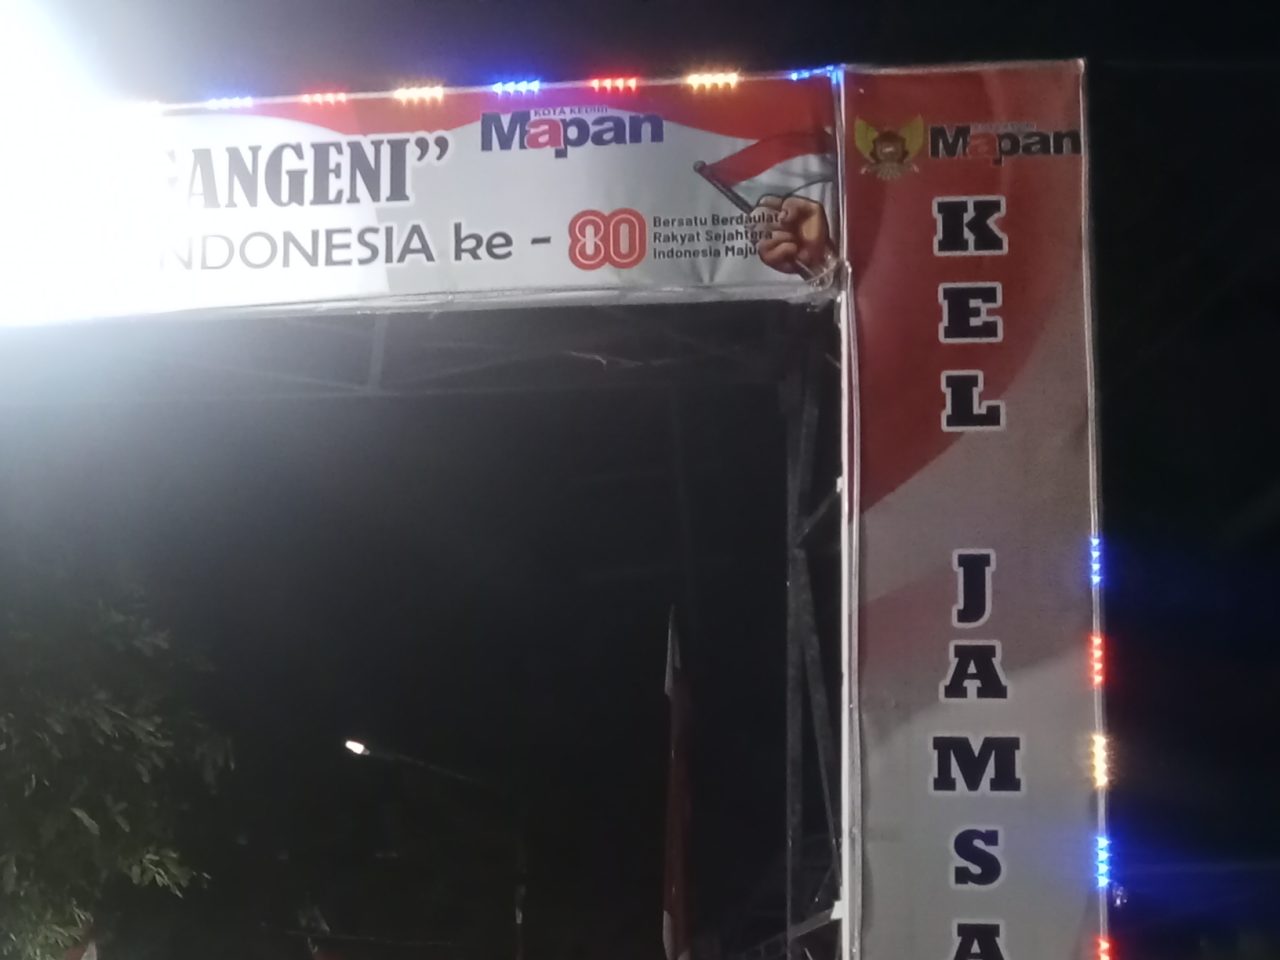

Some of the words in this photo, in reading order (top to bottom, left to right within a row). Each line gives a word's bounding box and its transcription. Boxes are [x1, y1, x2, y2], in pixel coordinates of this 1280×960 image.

[480, 109, 665, 159] Mapan
[929, 125, 1082, 167] Mapan
[166, 133, 450, 210] ANGENI”
[159, 223, 436, 272] NDONESIA
[453, 219, 513, 262] ke
[567, 207, 648, 271] 80
[653, 215, 709, 229] Bersatu
[711, 212, 780, 227] Berdaulat
[653, 230, 703, 244] Rakyat
[704, 228, 773, 244] Sejahtera
[653, 246, 721, 260] Indonesia
[724, 244, 758, 258] Maju
[934, 197, 1006, 430] KEL
